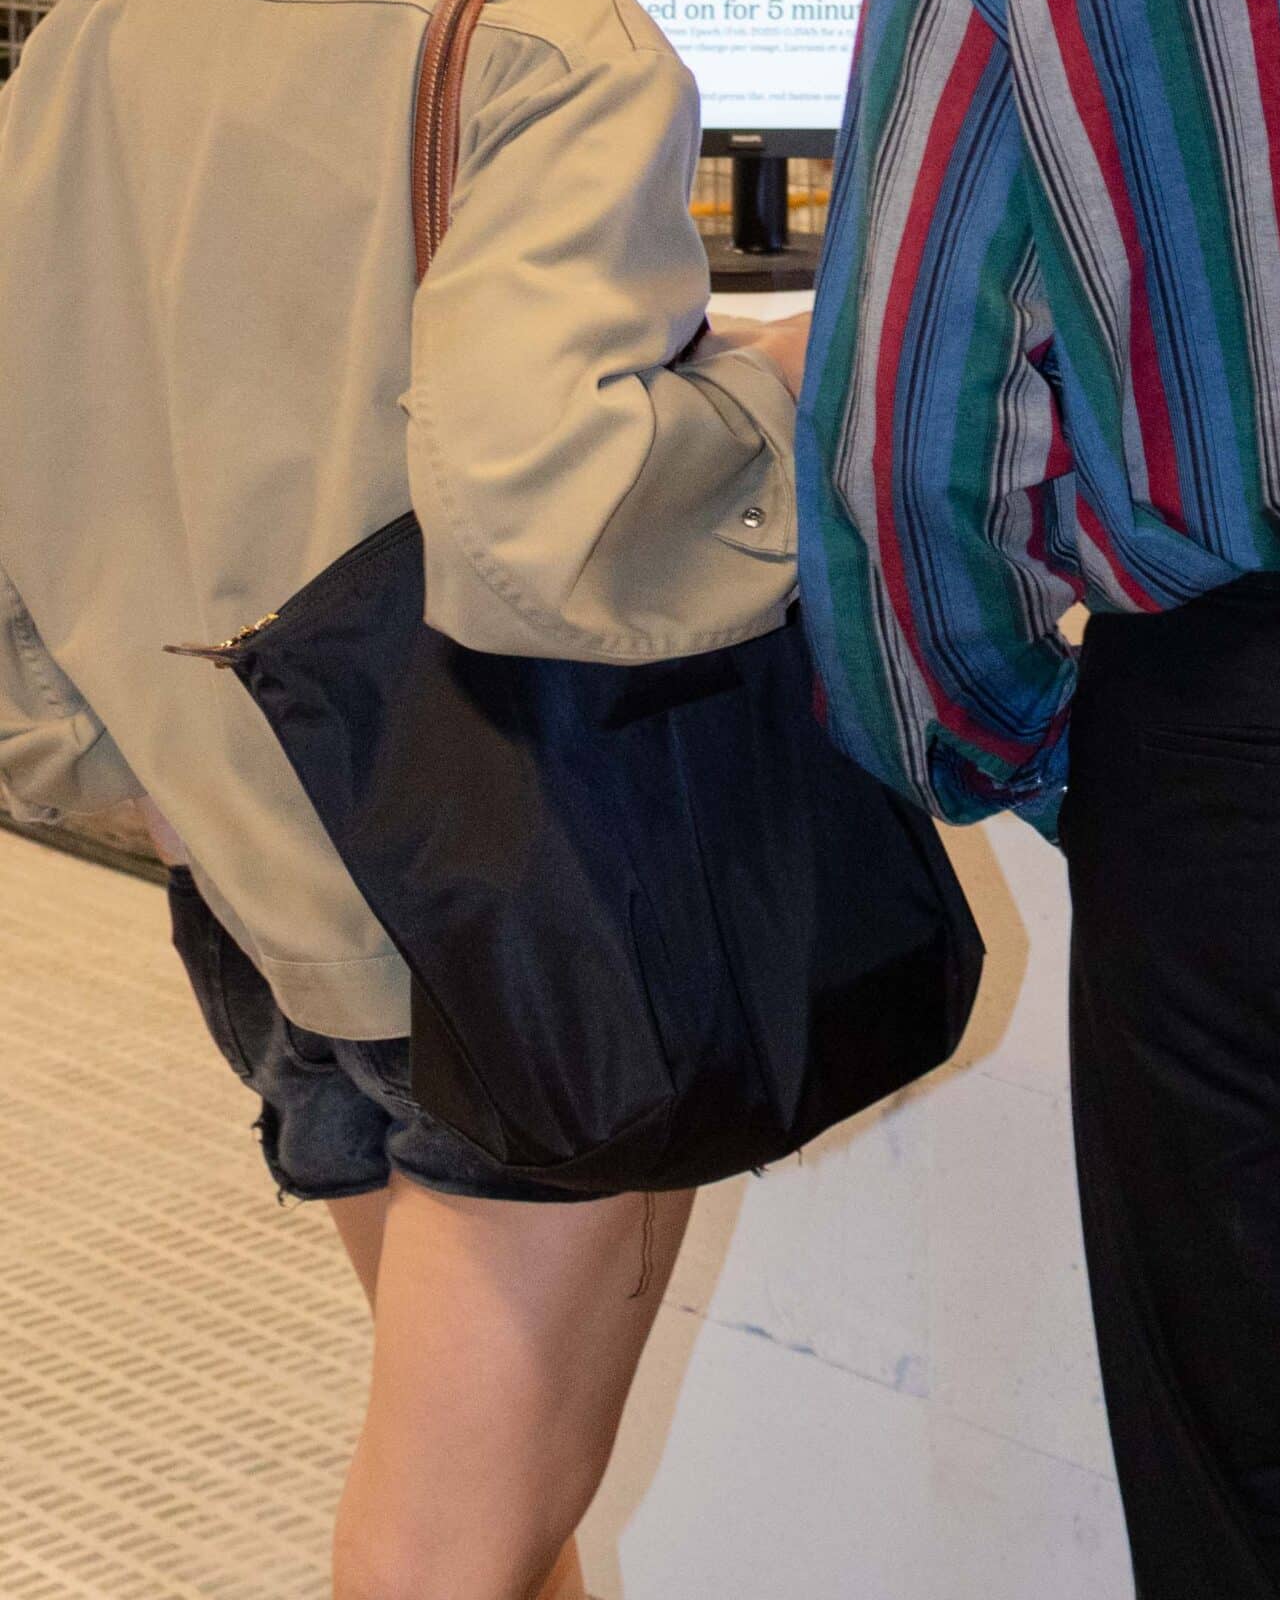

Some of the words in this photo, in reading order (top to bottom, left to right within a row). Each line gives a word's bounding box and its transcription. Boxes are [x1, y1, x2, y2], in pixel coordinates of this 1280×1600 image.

[684, 3, 715, 20] on
[723, 0, 760, 20] for
[767, 0, 783, 20] 5
